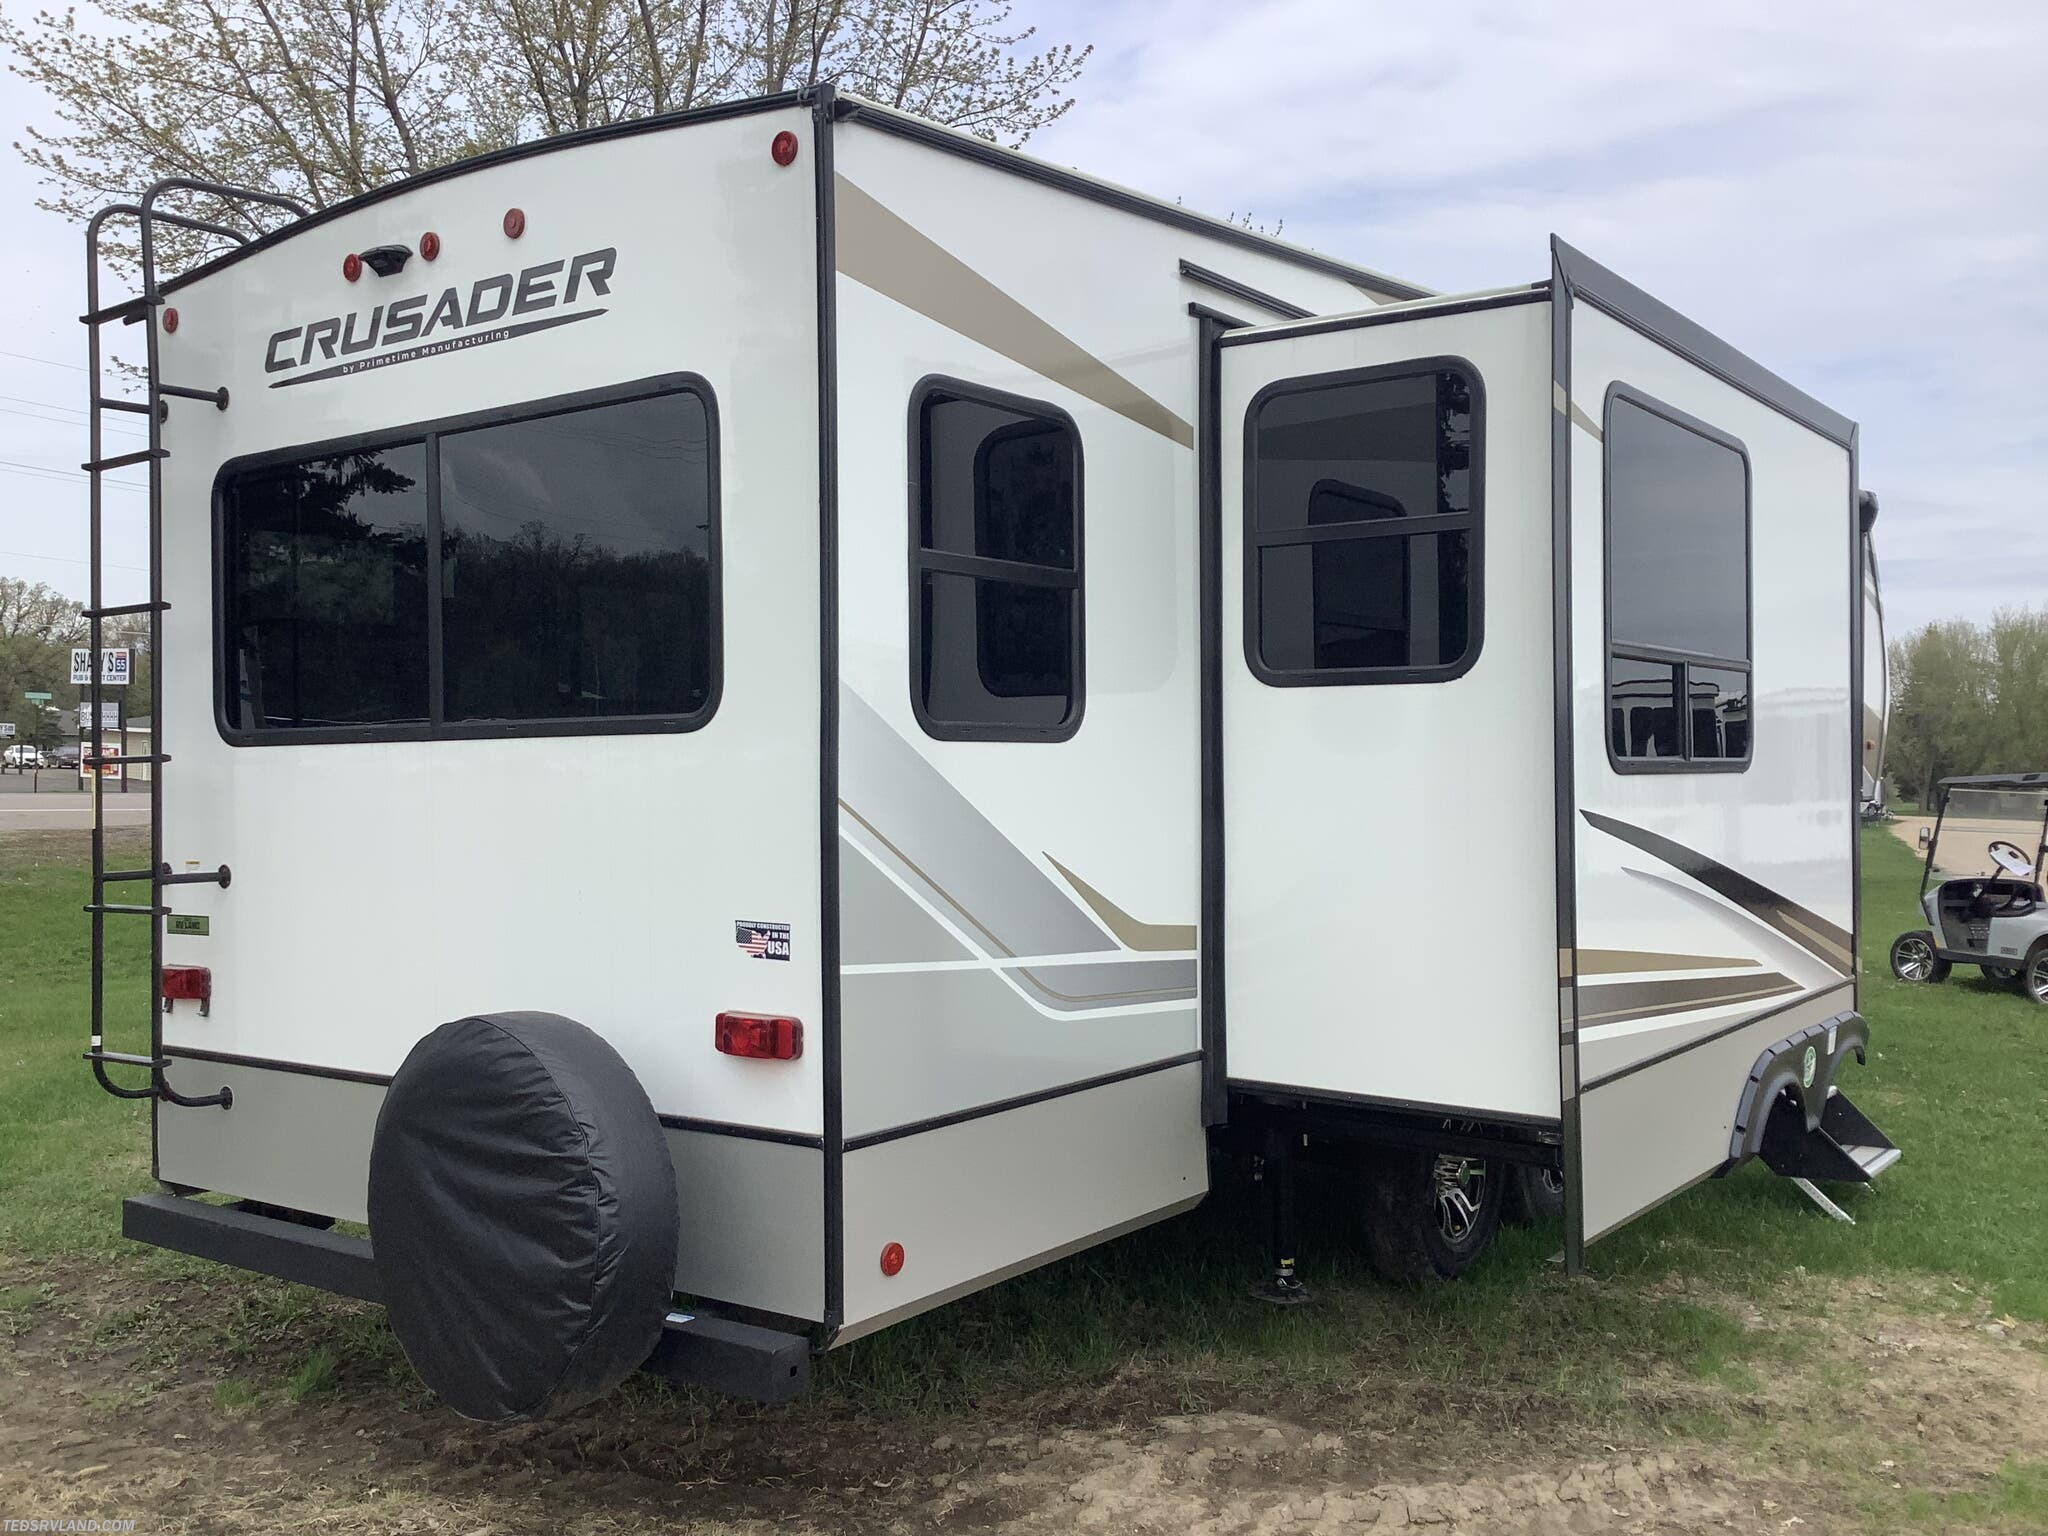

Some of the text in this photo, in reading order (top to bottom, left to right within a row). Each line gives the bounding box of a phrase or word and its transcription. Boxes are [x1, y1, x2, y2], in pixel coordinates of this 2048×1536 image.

[265, 247, 617, 373] CRUSADER
[343, 330, 510, 374] by Primetime Manufacturing
[74, 651, 114, 672] SHAY'S
[771, 931, 779, 939] IN
[767, 940, 789, 956] USA
